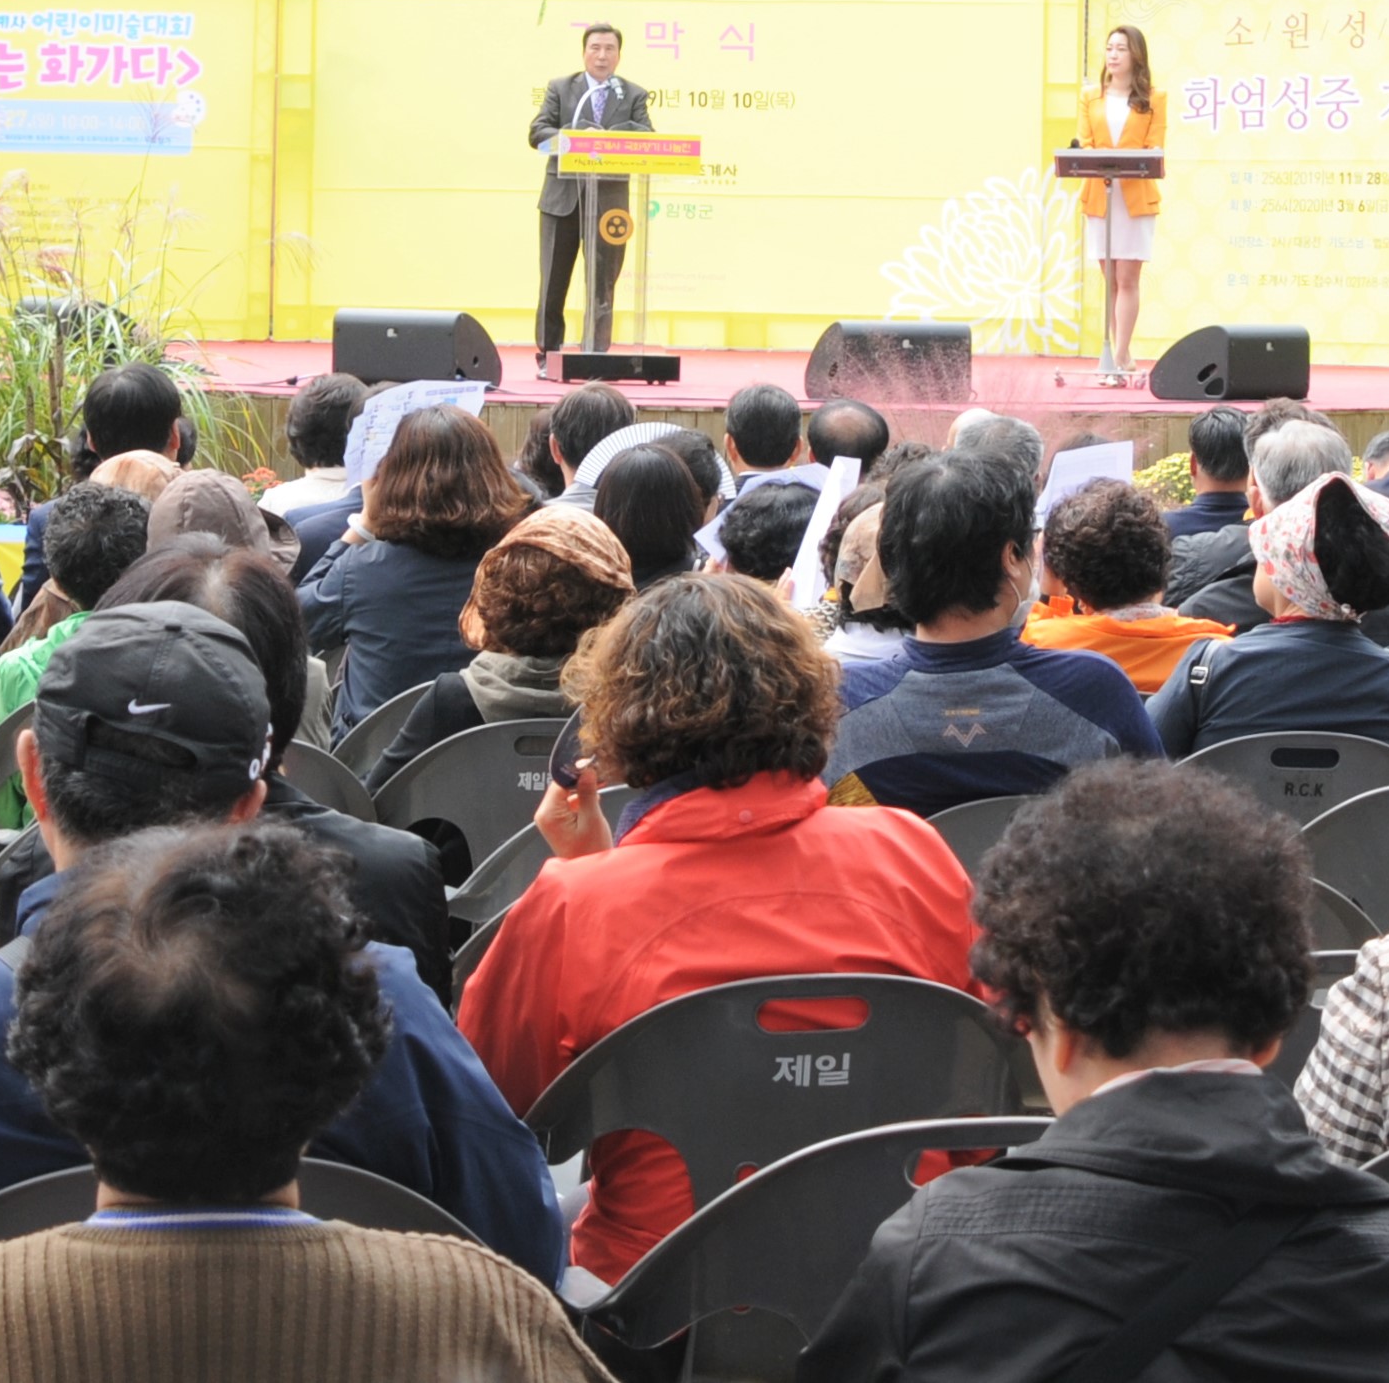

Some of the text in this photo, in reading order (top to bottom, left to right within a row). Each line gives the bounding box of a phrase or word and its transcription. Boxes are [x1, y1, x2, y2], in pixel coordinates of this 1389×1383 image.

[32, 11, 192, 39] 어린이미술대회
[688, 90, 726, 110] 10월
[1183, 75, 1360, 131] 화엄성중
[772, 1053, 851, 1088] 제일
